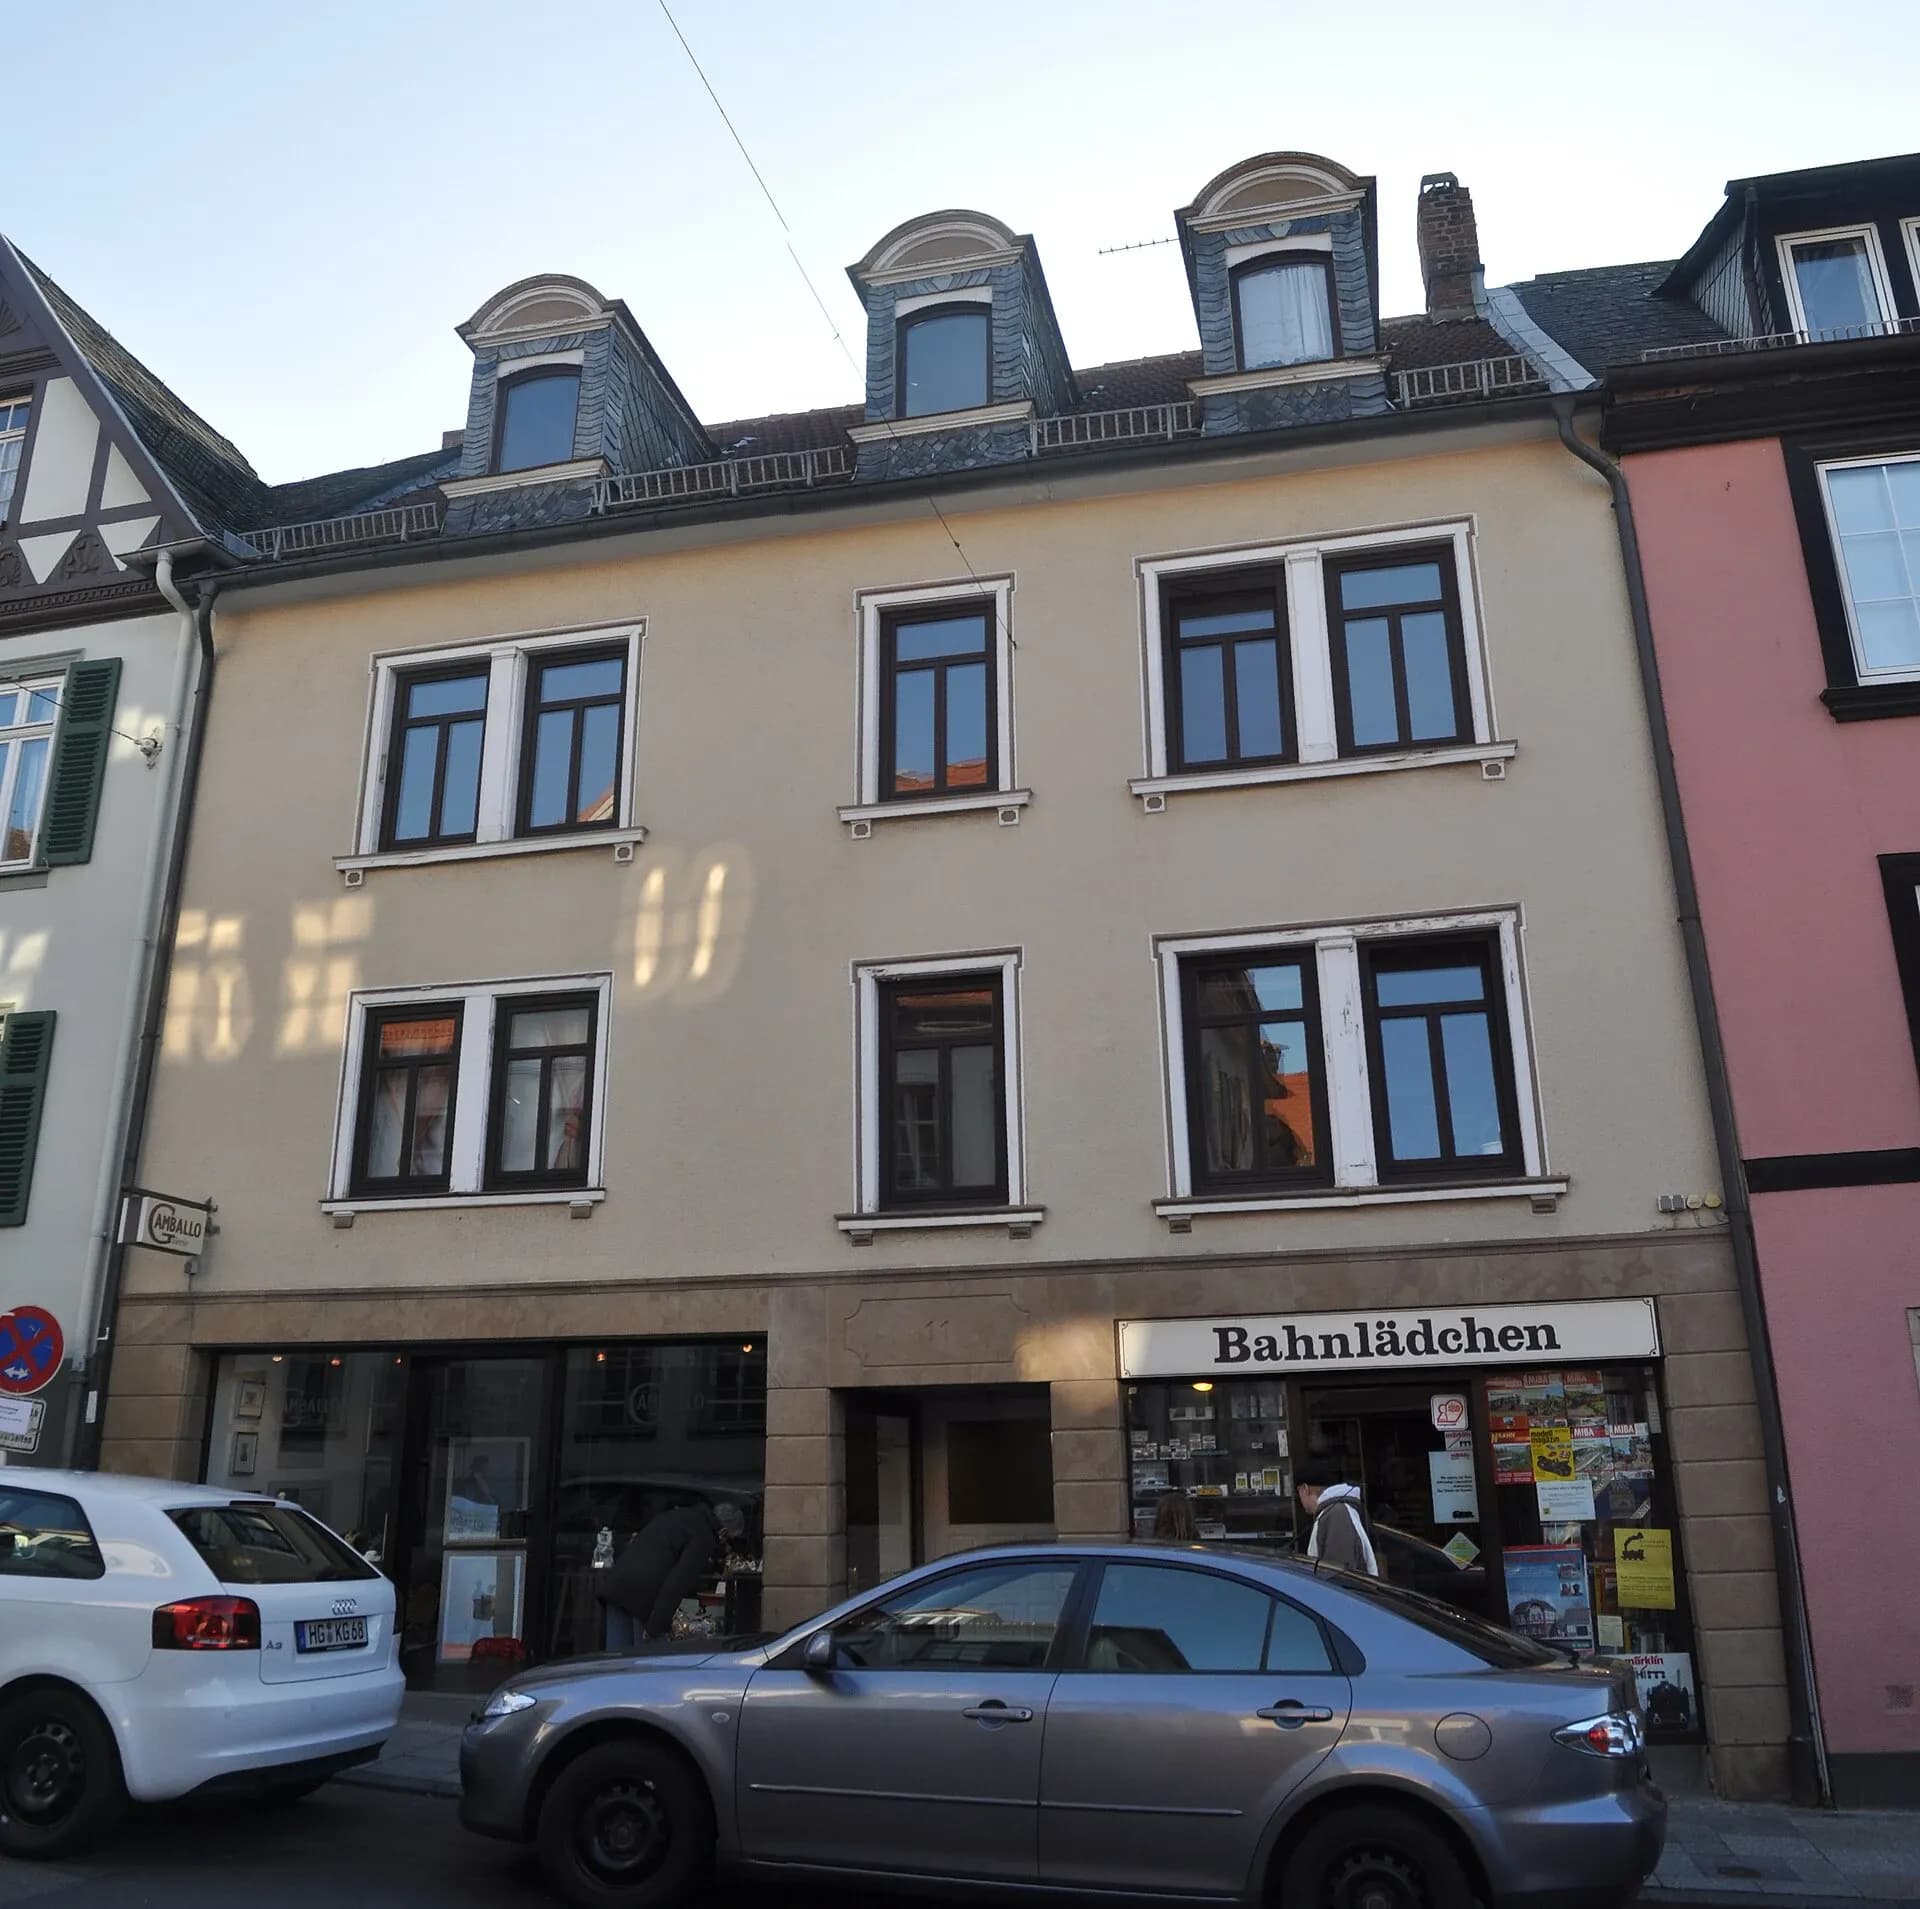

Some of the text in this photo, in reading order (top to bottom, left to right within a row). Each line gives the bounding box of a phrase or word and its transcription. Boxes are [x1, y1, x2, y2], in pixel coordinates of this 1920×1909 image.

[148, 1203, 202, 1244] GAMBALLO
[1213, 1317, 1561, 1363] Bahnlädchen
[1573, 1427, 1594, 1437] MIBA
[1613, 1424, 1634, 1435] MIBA
[308, 1624, 325, 1645] HG
